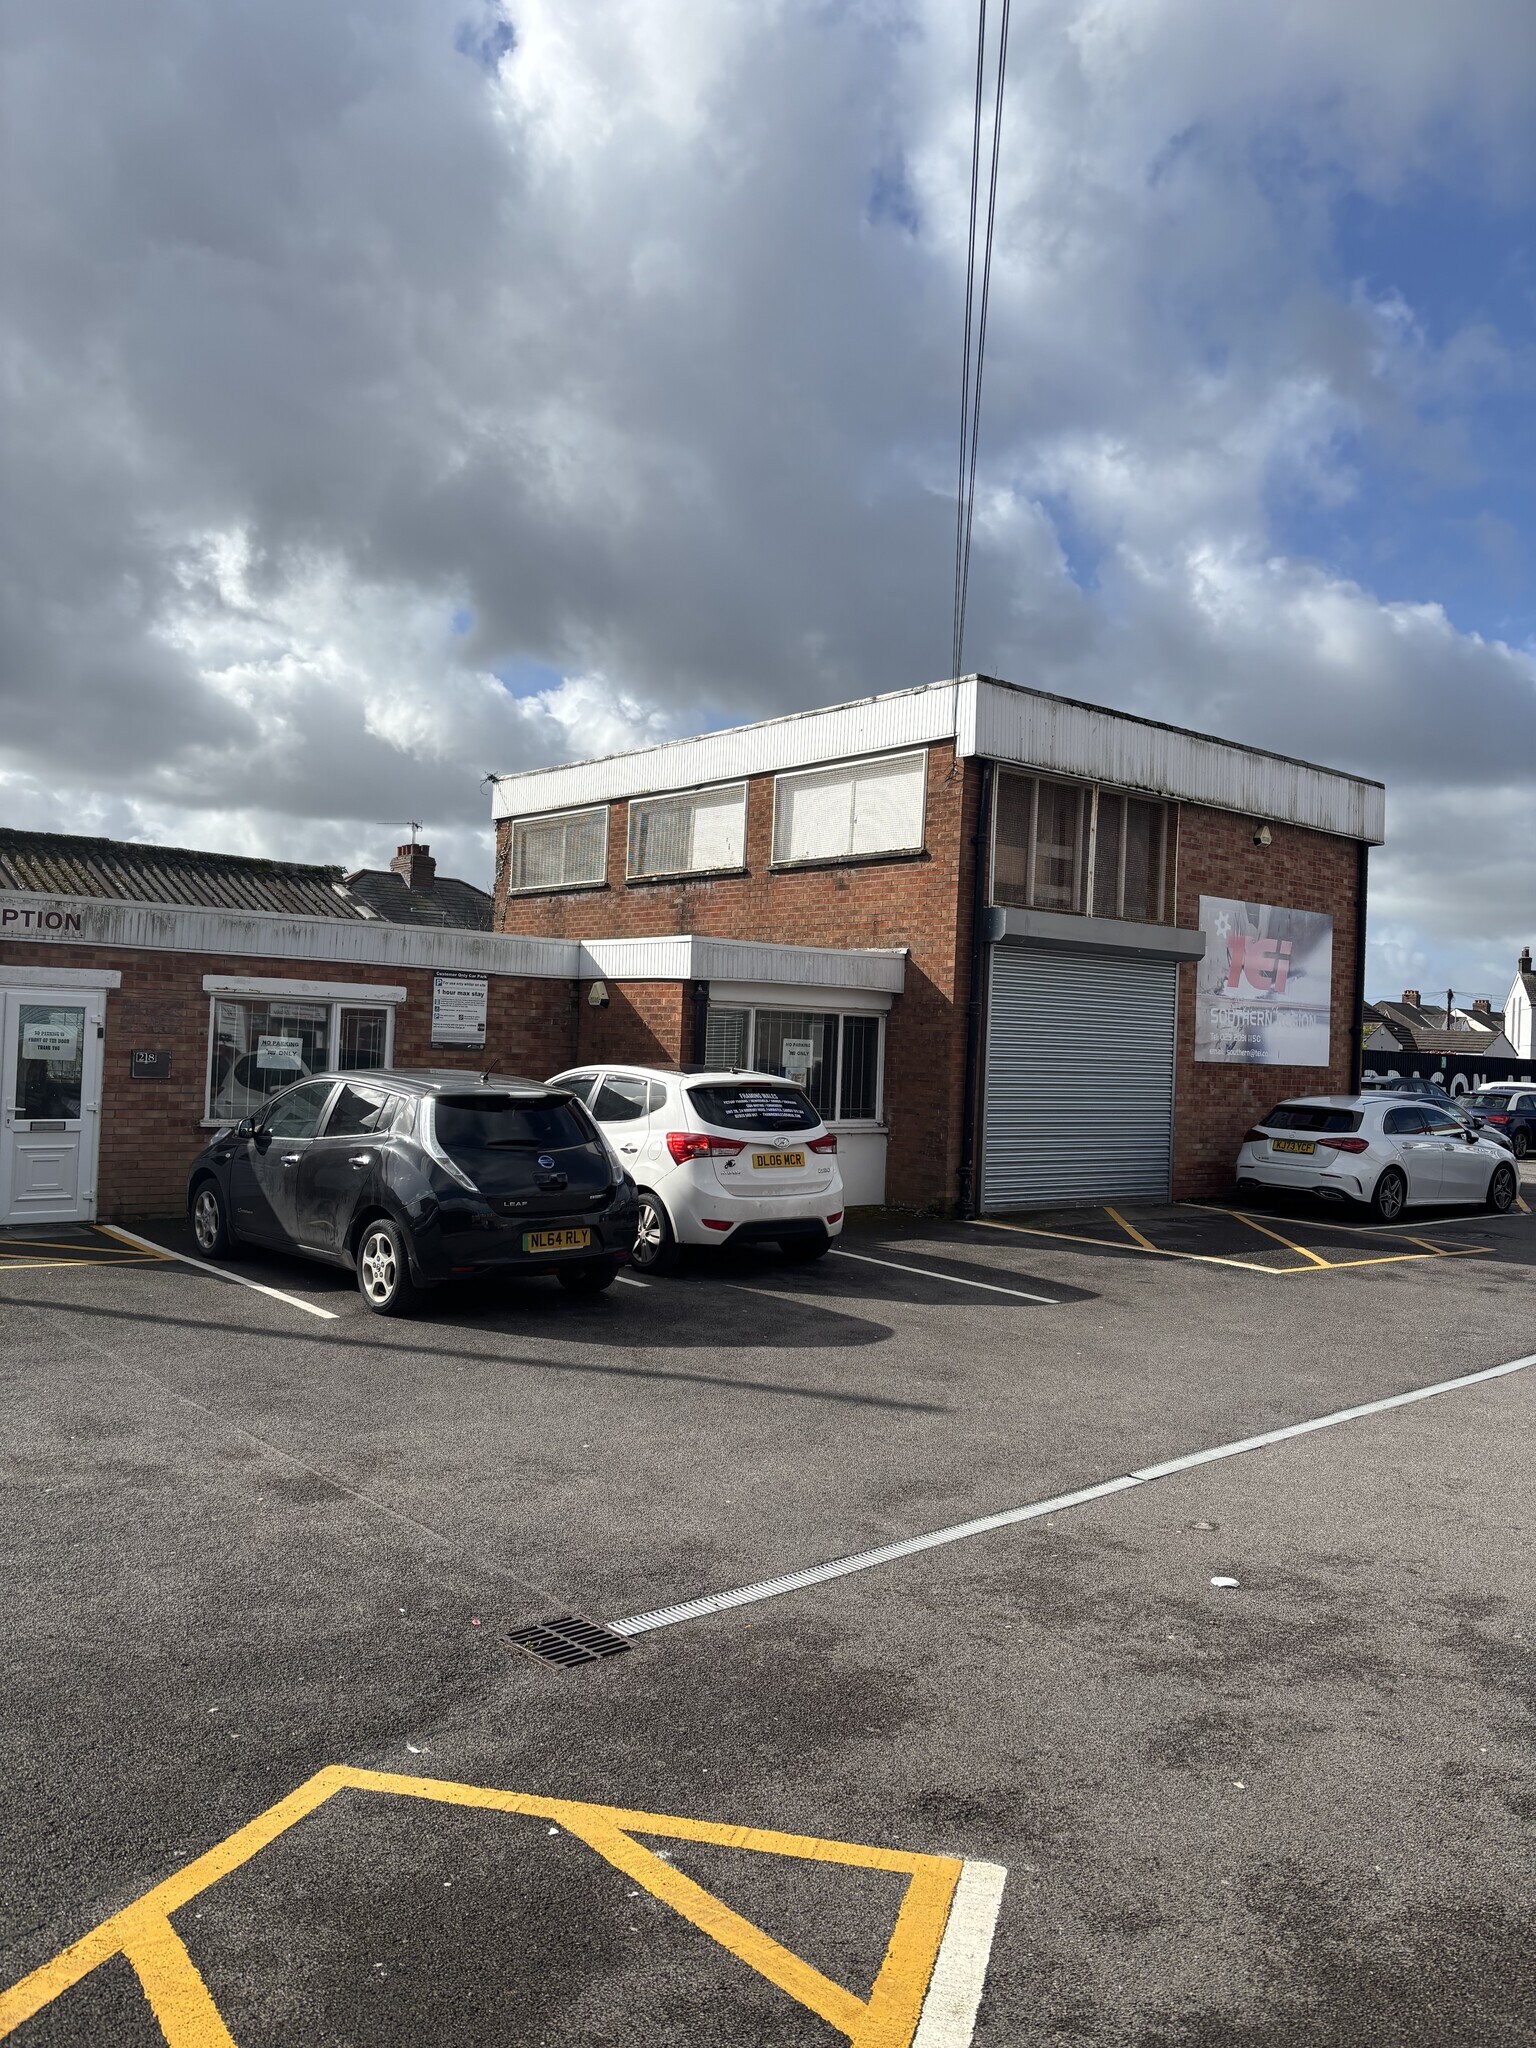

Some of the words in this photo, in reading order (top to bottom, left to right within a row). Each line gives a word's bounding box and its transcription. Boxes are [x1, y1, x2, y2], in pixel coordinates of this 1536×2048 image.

[2, 908, 82, 931] PTION
[1210, 1006, 1273, 1028] SOUTHERN
[1276, 1141, 1296, 1150] KJ73
[1297, 1143, 1312, 1152] YCF
[757, 1154, 782, 1166] DL06
[784, 1154, 802, 1165] MCR
[531, 1232, 563, 1248] NL64
[566, 1229, 588, 1245] RLY
